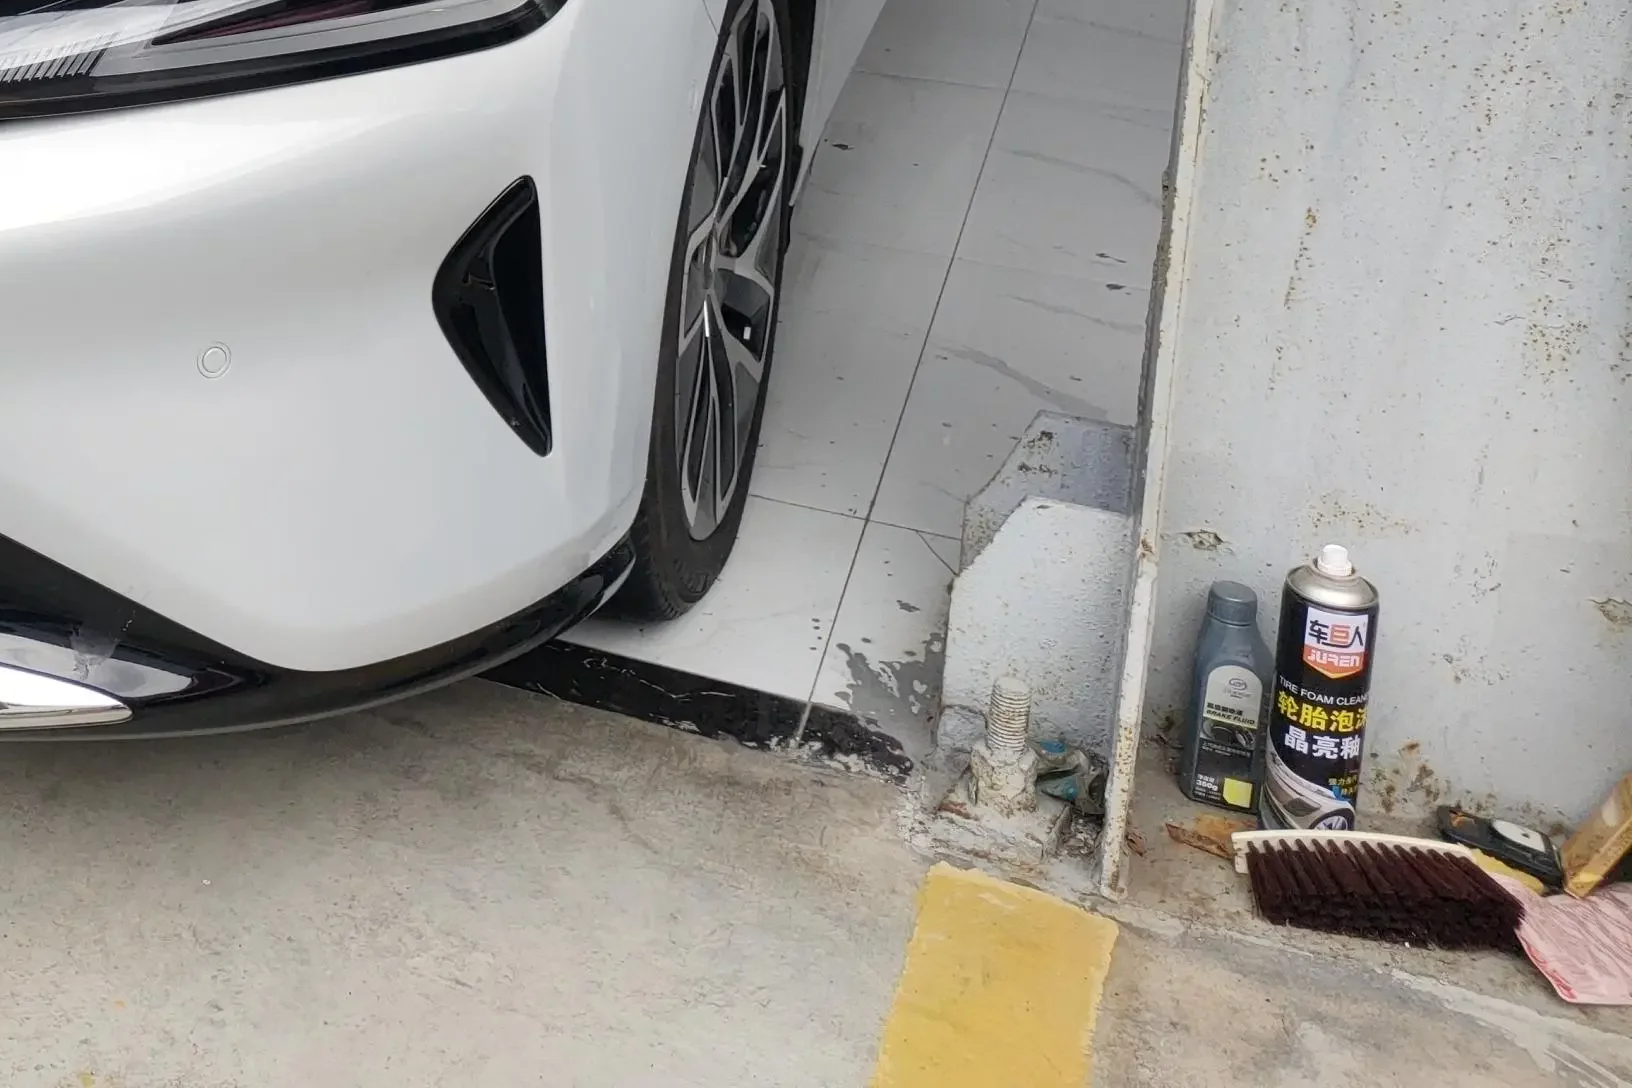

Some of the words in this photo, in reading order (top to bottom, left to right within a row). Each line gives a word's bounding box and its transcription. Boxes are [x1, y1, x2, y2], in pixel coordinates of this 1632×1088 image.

[1308, 619, 1364, 648] 车巨人
[1279, 675, 1299, 694] TIRE
[1300, 688, 1334, 705] FOAM
[1206, 709, 1232, 720] BRAKE
[1233, 715, 1255, 725] FLUID
